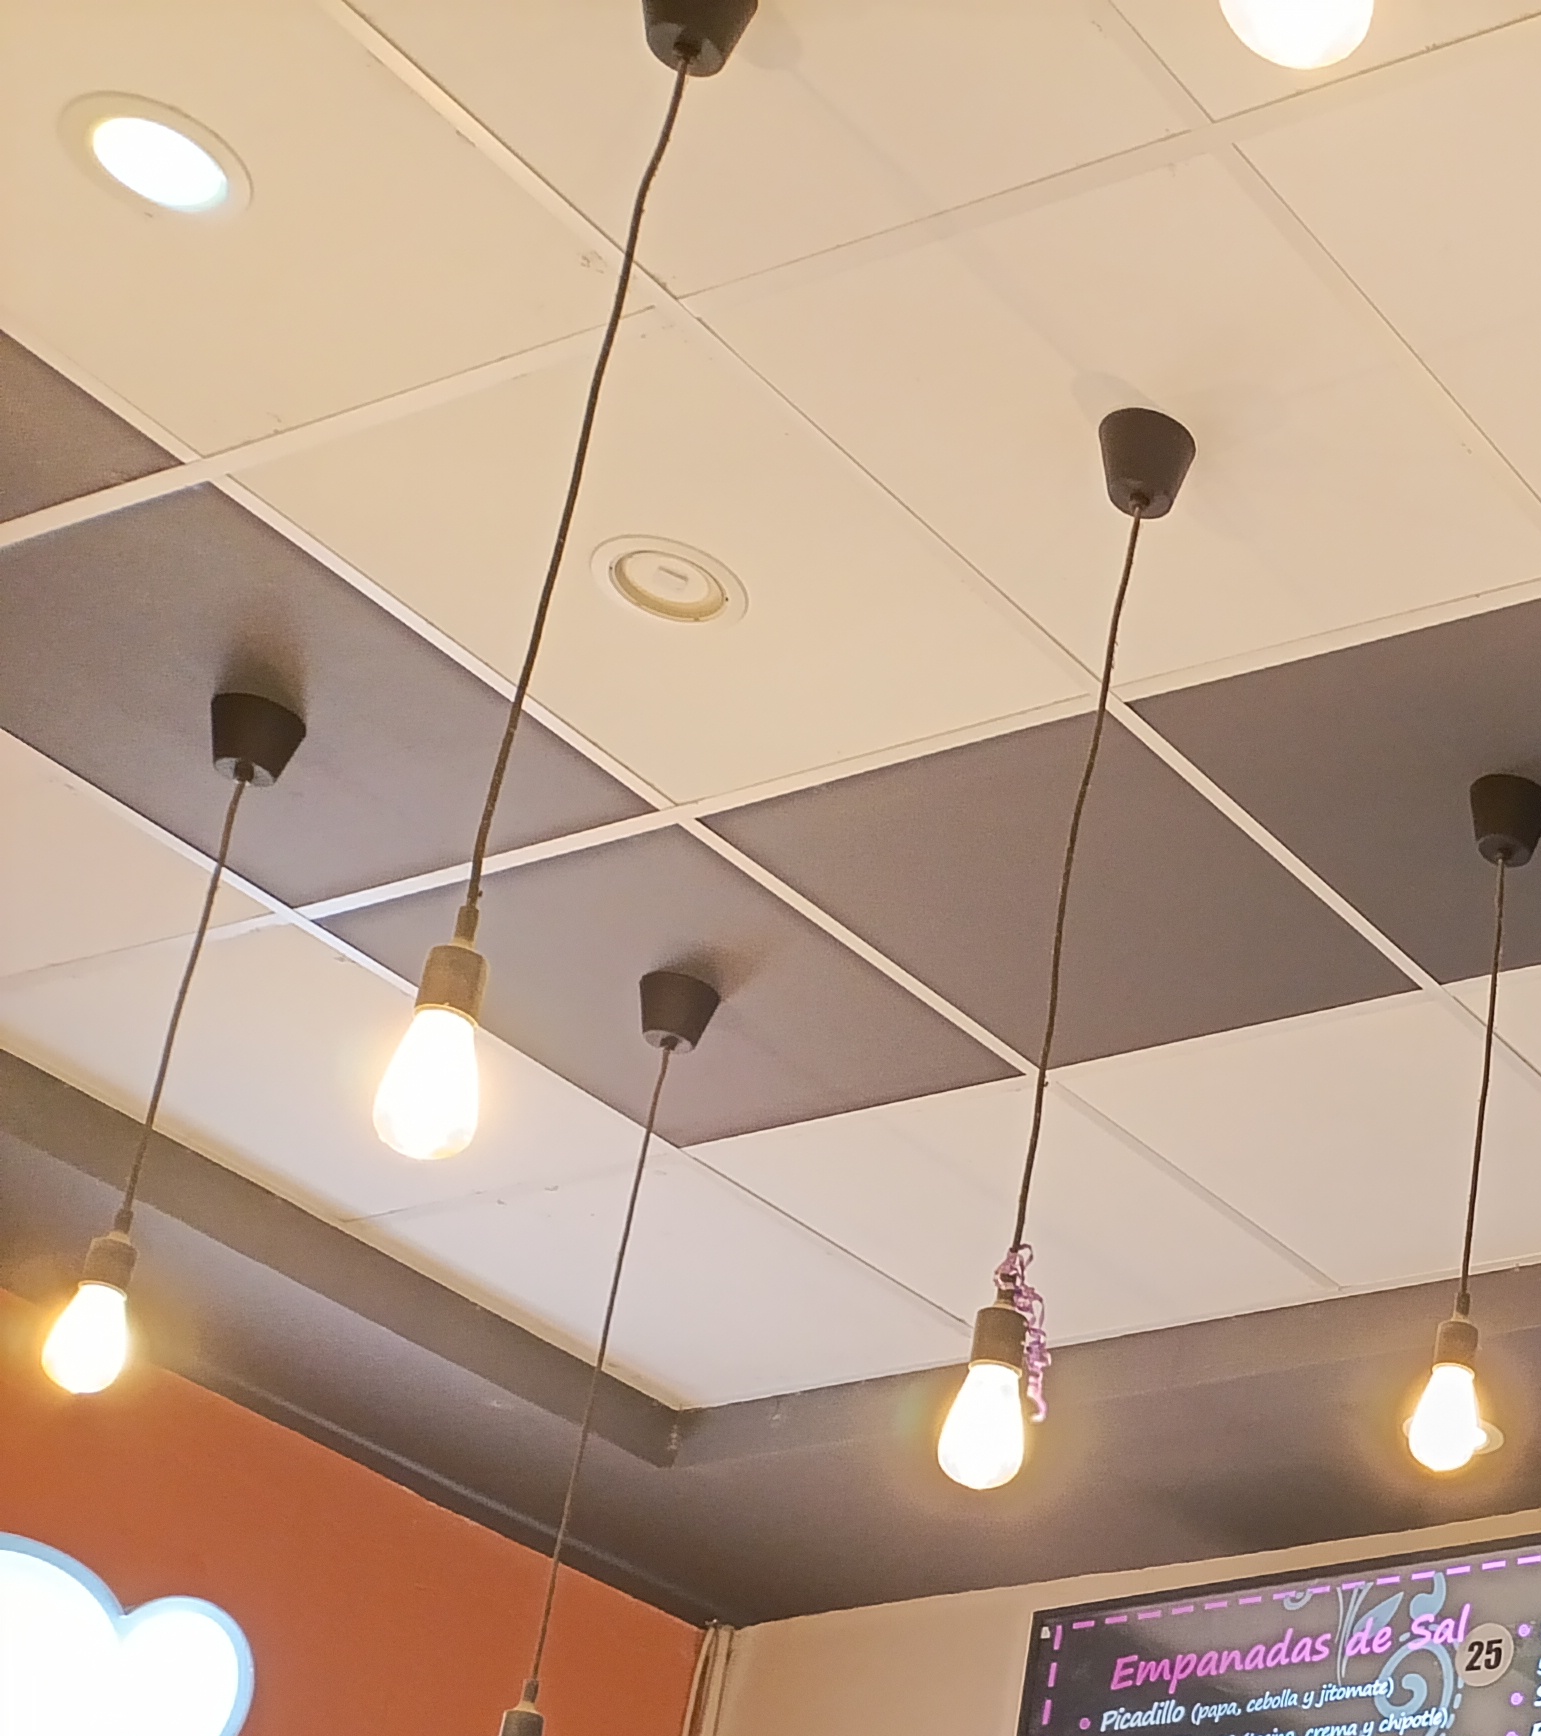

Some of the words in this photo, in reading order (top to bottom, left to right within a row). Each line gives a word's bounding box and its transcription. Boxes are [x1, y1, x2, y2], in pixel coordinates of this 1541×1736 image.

[1110, 1632, 1330, 1693] Empanadas
[1345, 1625, 1392, 1655] de
[1407, 1604, 1471, 1649] Sal
[1465, 1641, 1503, 1672] 25
[1100, 1703, 1184, 1731] Picadillo
[1190, 1700, 1239, 1726] (papa,
[1247, 1693, 1297, 1711] cebolla
[1303, 1690, 1314, 1708] y
[1316, 1678, 1393, 1704] jitomate)
